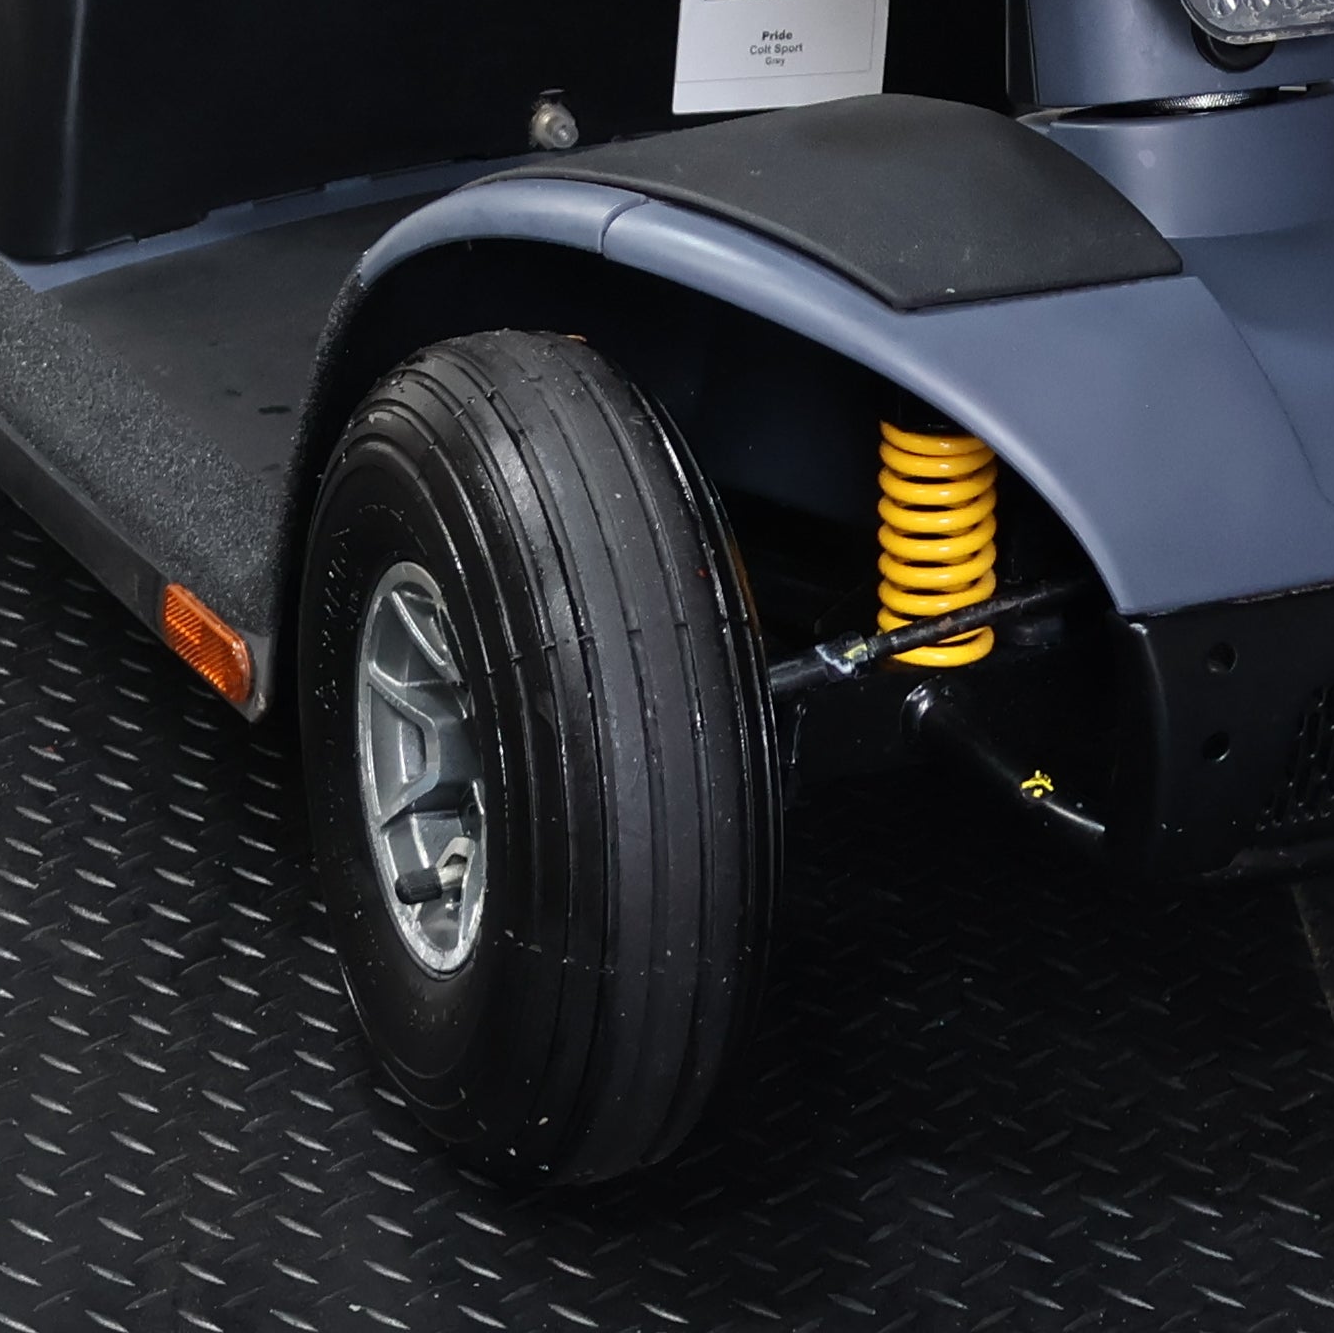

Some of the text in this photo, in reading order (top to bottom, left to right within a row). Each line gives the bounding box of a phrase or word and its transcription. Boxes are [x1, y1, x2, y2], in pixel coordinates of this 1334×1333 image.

[762, 29, 793, 41] Pride
[750, 43, 803, 56] Colt Sport
